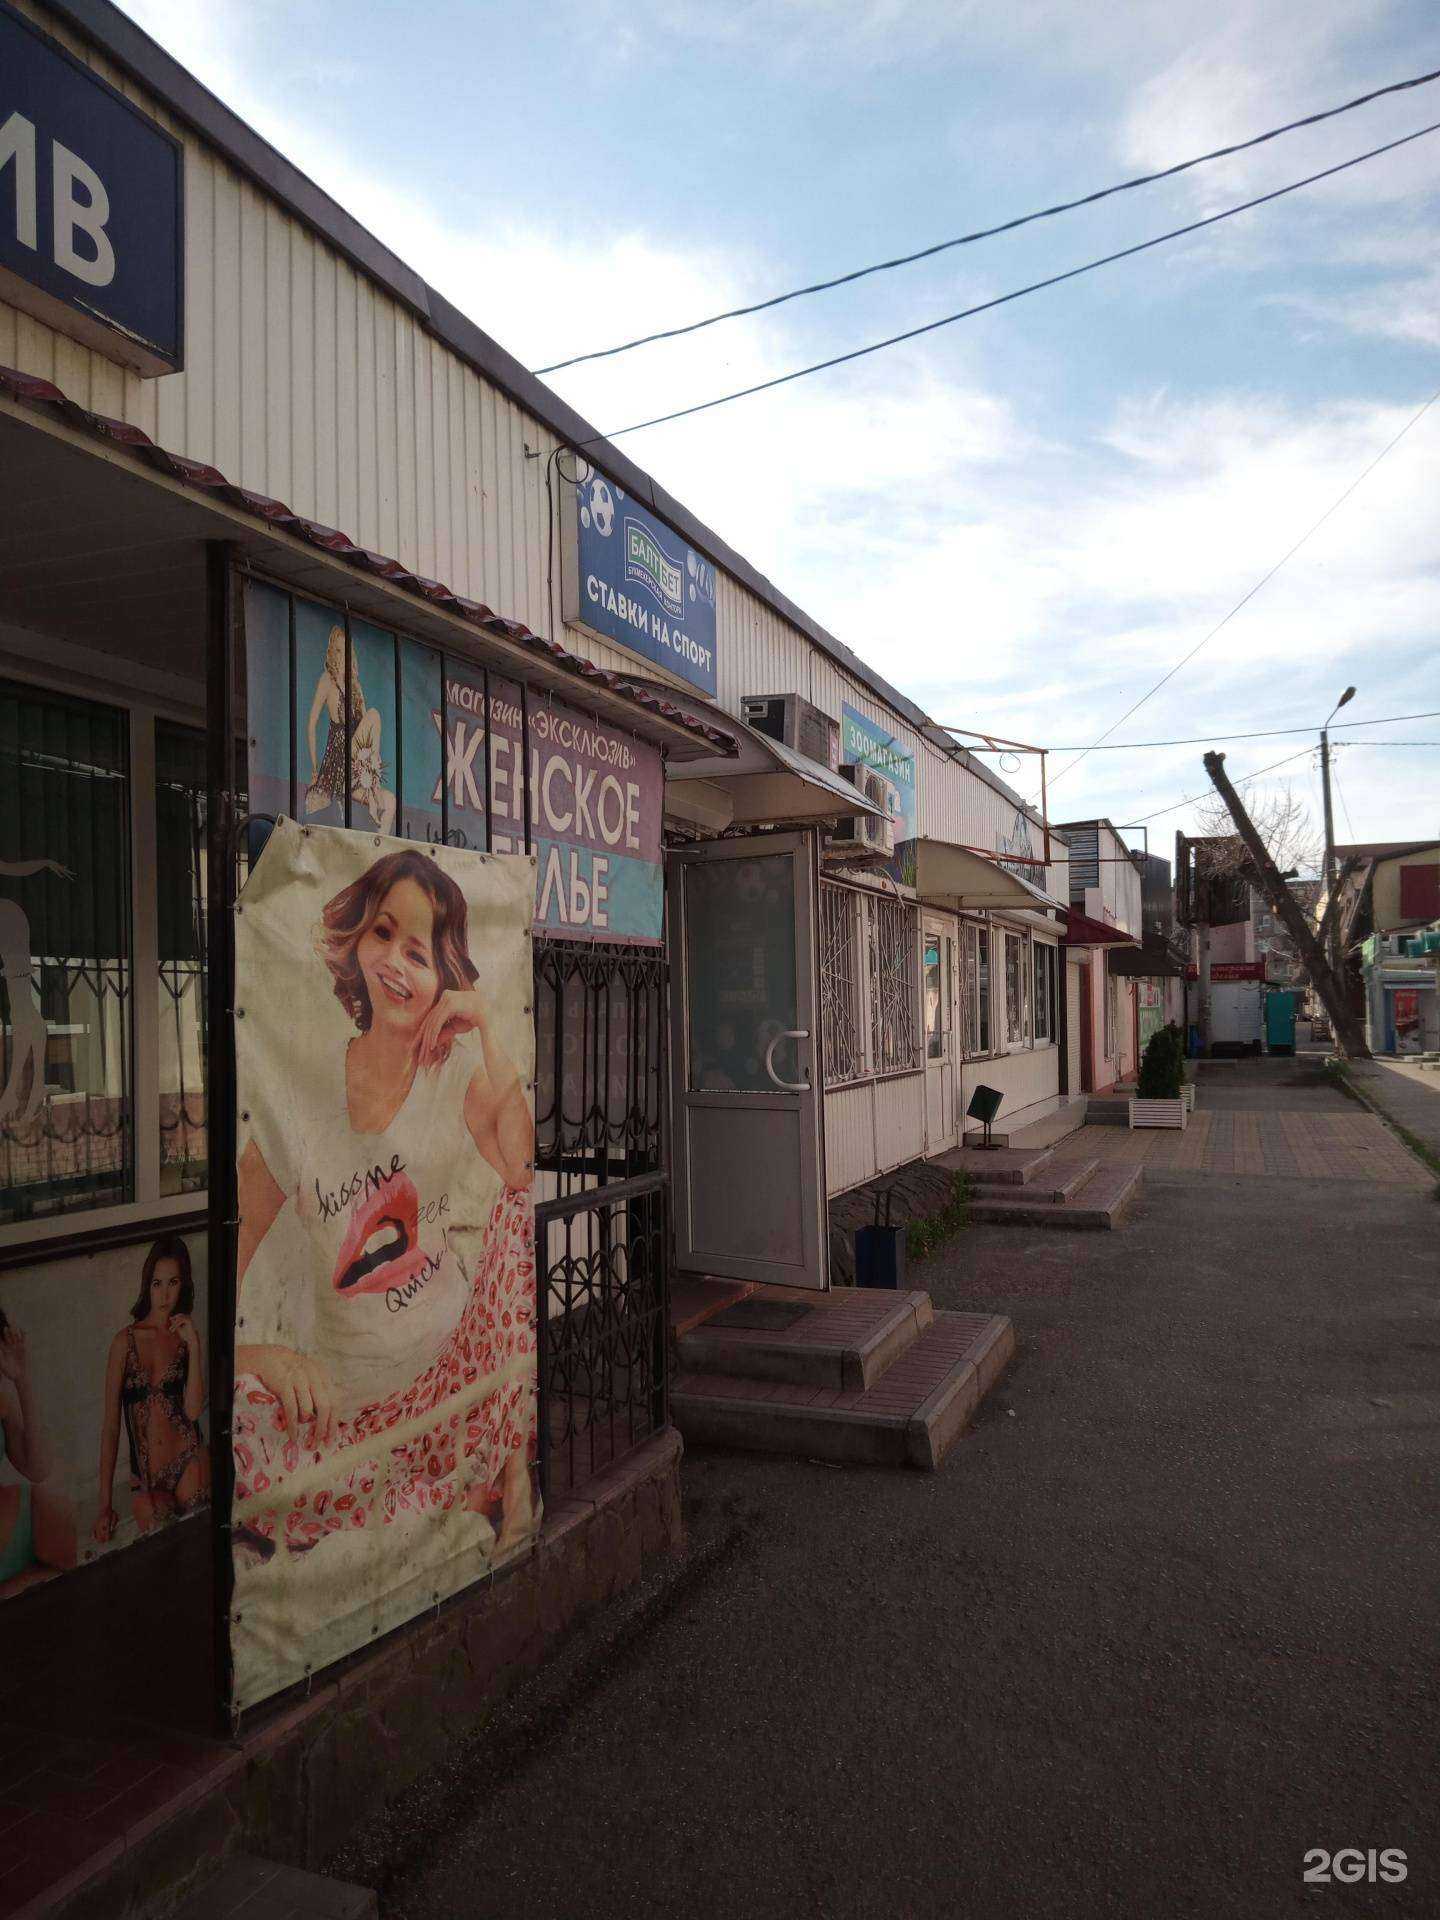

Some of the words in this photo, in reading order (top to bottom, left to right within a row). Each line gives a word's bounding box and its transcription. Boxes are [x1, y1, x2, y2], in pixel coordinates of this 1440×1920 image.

[587, 574, 649, 633] СТАВКИ
[651, 614, 671, 649] НА
[672, 630, 712, 673] СПОРТ
[432, 710, 640, 850] ЖЕНСКОЕ
[850, 726, 911, 783] ЗООМАГАЗИН
[491, 834, 608, 927] ЛЬЕ
